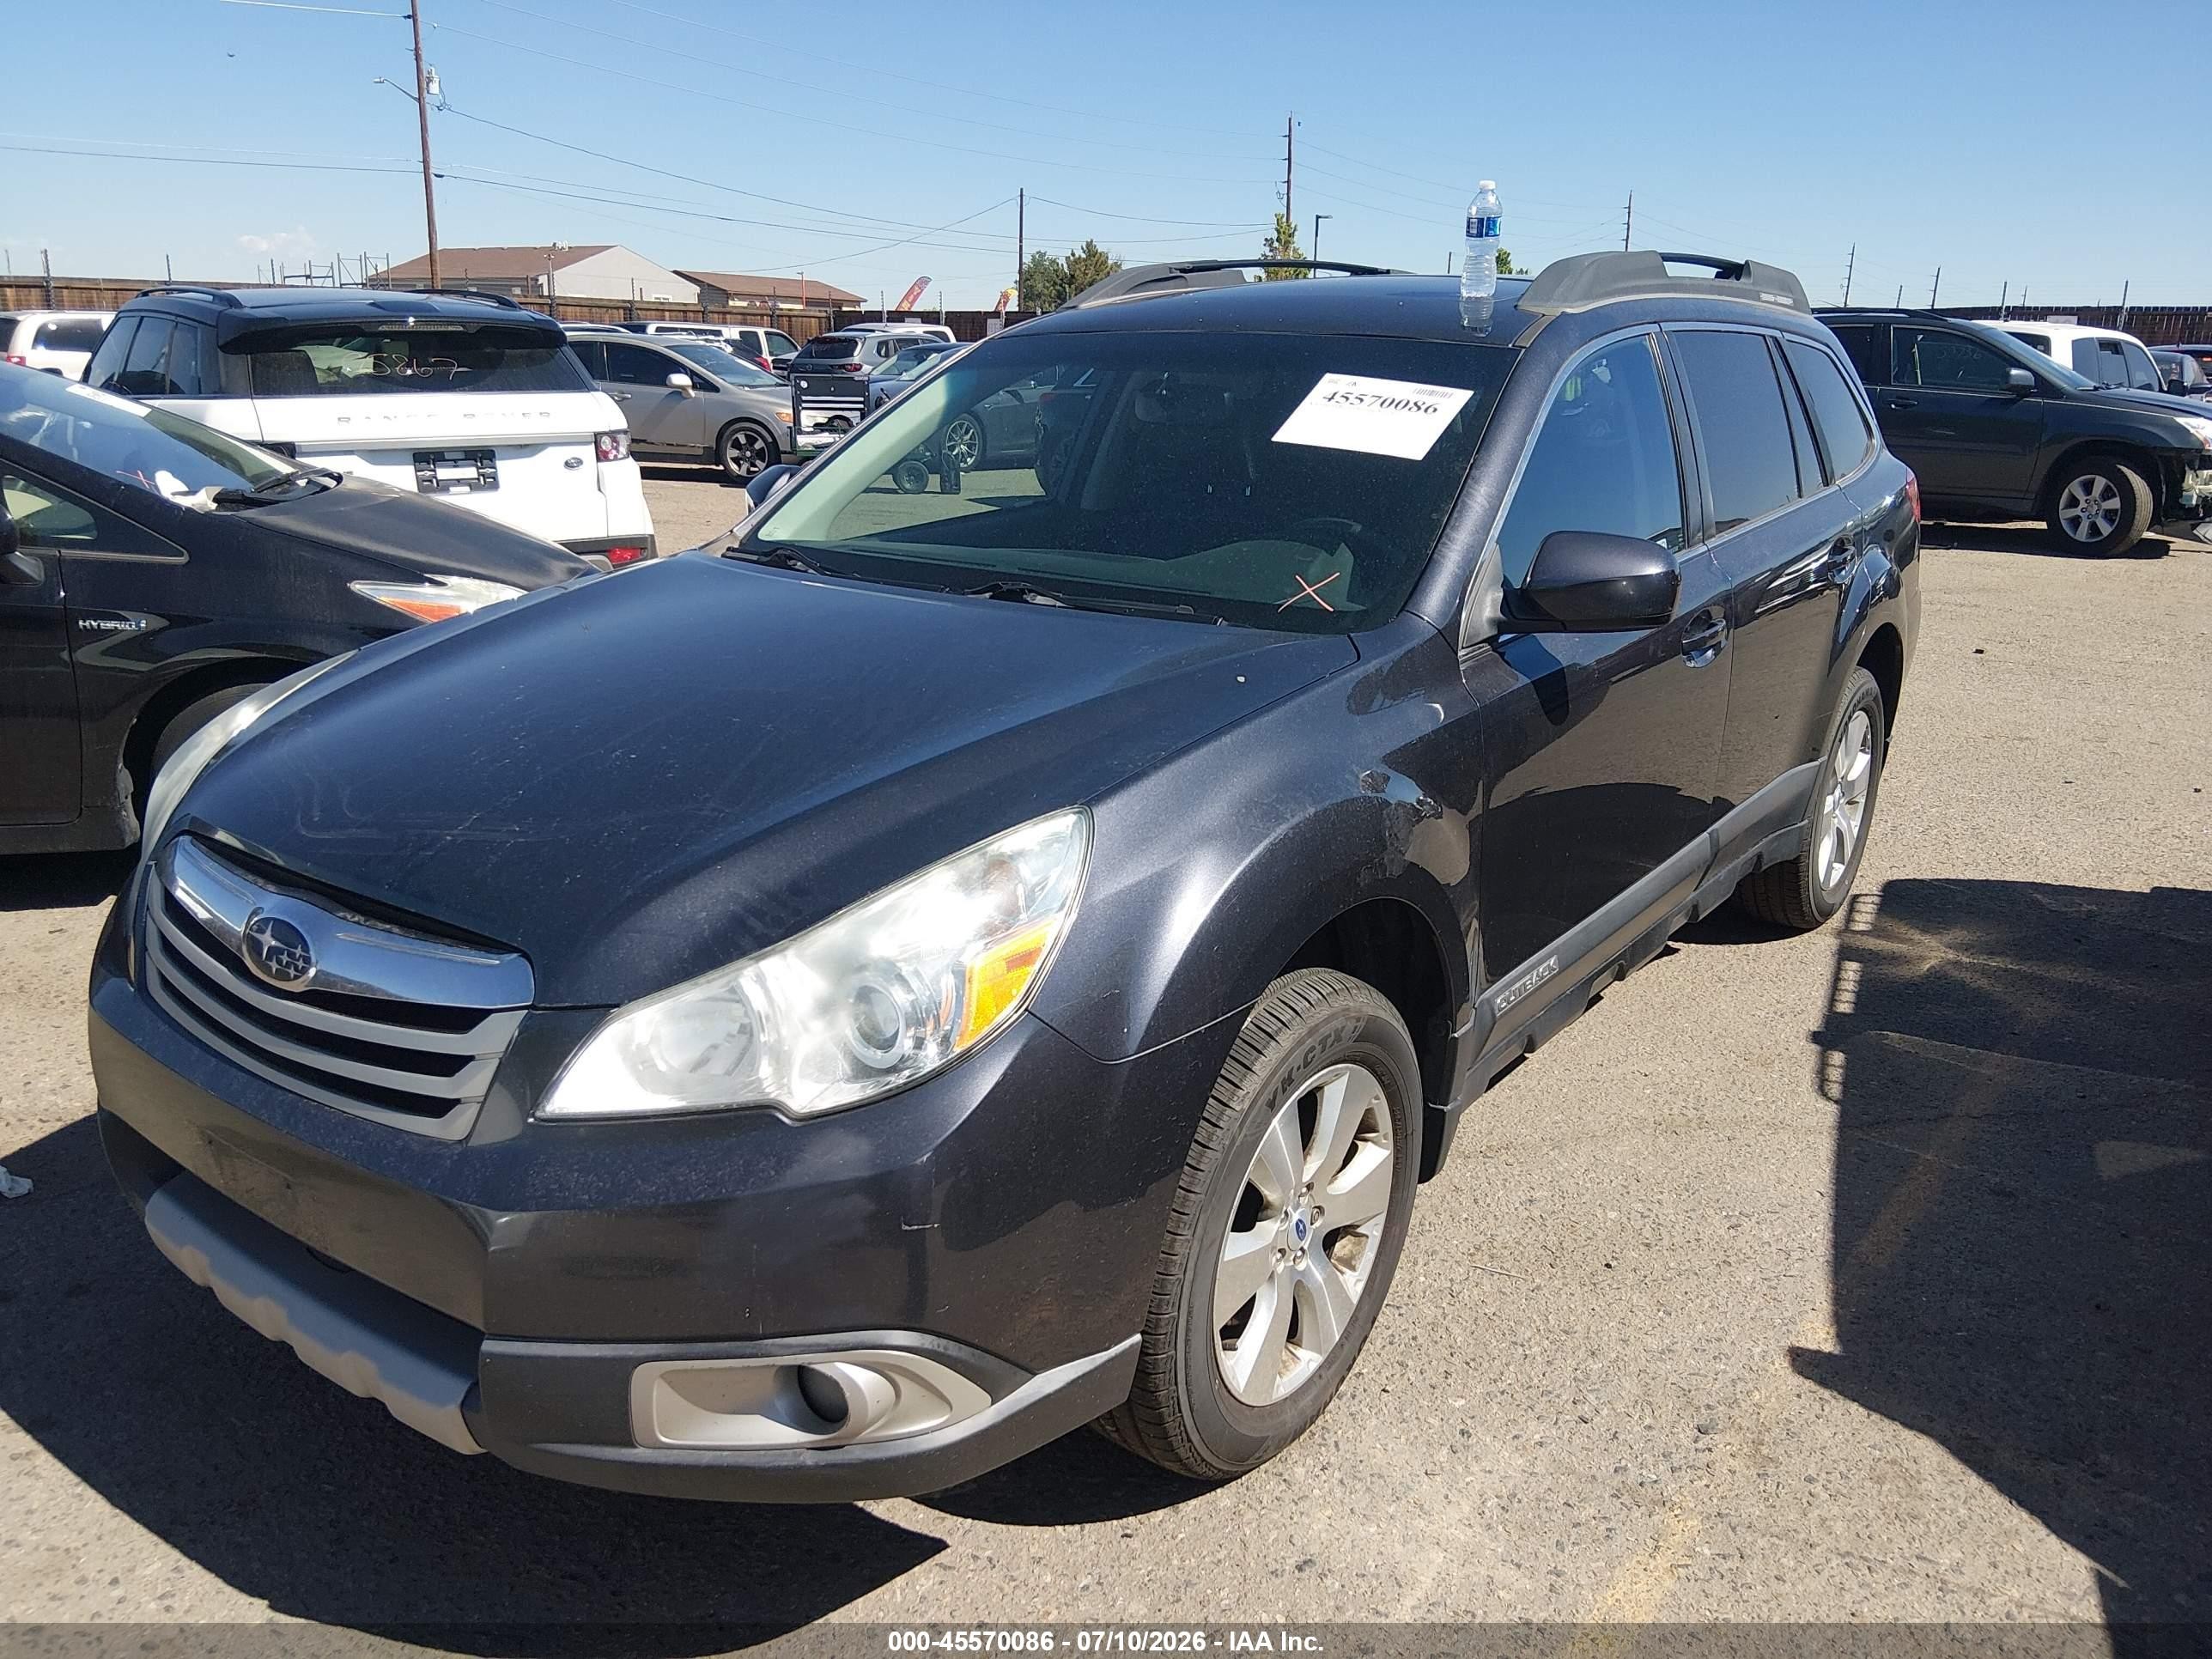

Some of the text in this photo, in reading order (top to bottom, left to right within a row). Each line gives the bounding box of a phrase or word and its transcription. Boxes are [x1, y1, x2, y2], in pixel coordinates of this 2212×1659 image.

[1322, 391, 1440, 416] 45570086
[78, 619, 139, 630] HYBRID
[1497, 955, 1559, 1014] OUTBACK
